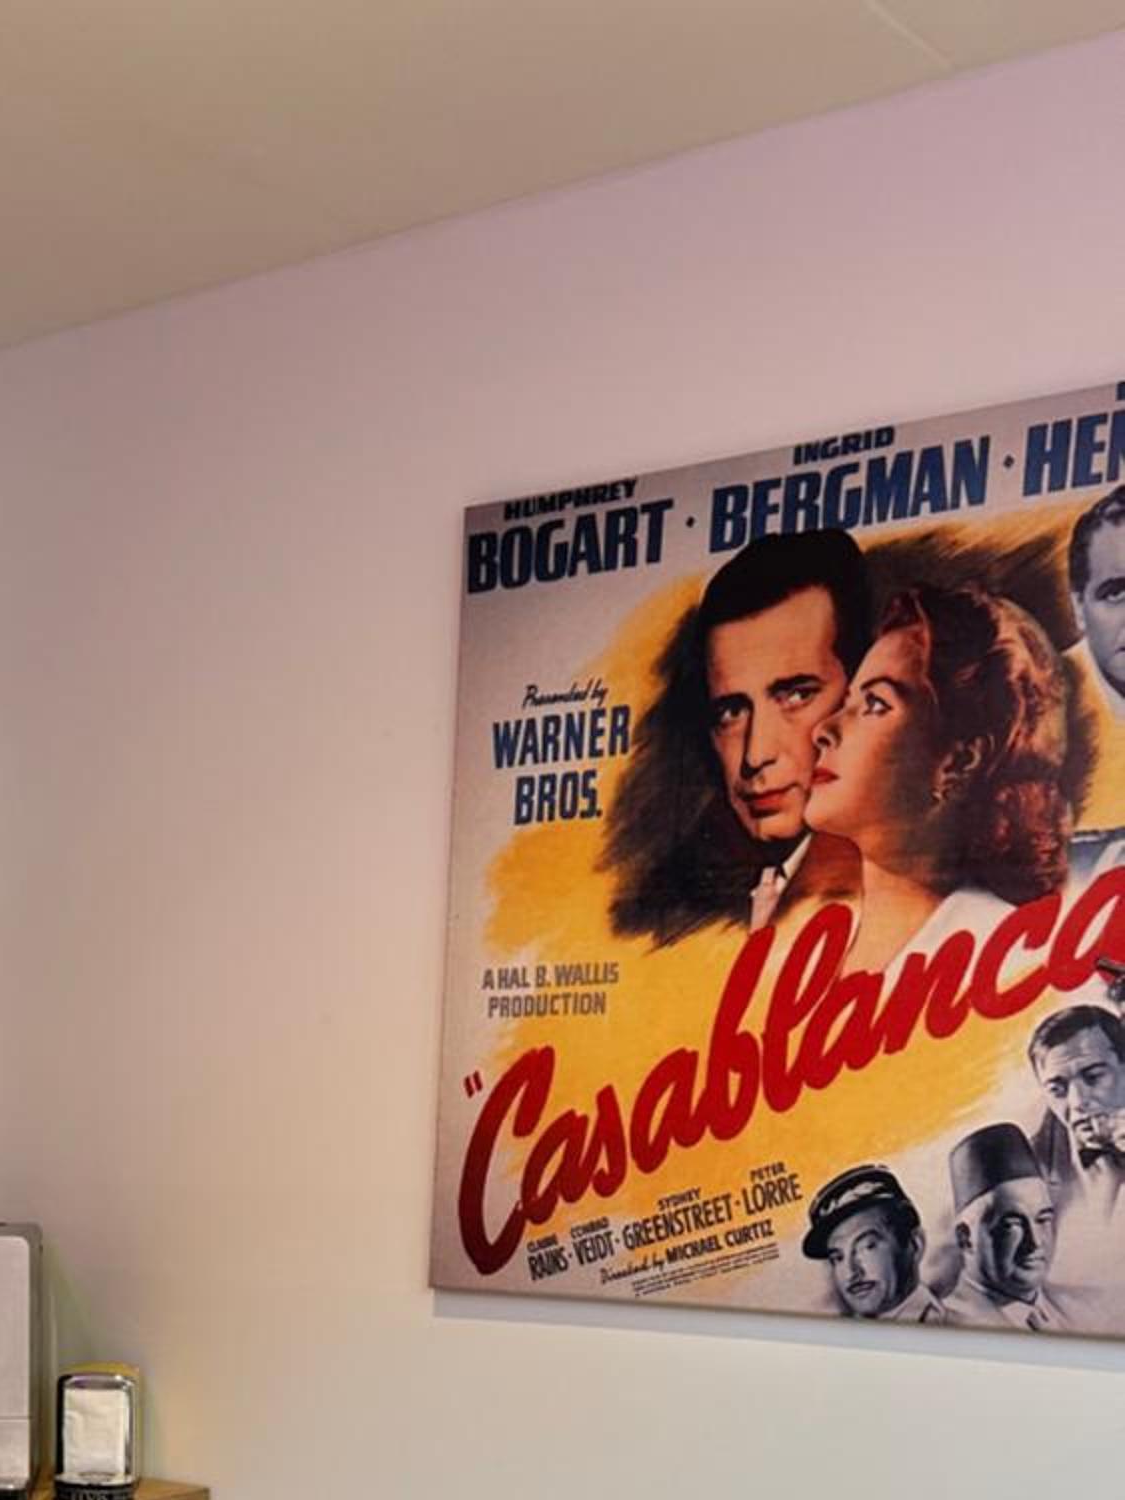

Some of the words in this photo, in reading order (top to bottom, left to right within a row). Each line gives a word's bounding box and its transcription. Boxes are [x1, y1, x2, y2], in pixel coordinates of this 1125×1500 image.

[793, 426, 895, 465] INGRID
[467, 498, 673, 594] BOGART
[709, 435, 991, 554] BERGMAN
[503, 479, 637, 520] HUMPHREY
[492, 704, 631, 769] WARNER
[514, 769, 602, 826] BROS.
[482, 968, 495, 990] A
[497, 965, 531, 989] HAL
[535, 964, 552, 988] B.
[554, 961, 620, 987] WALLIS
[487, 991, 607, 1019] PRODUCTION
[749, 1161, 787, 1183] PETER
[657, 1186, 702, 1212] SYDNEY
[527, 1245, 569, 1282] RAINS
[572, 1229, 615, 1266] VEIDT
[622, 1192, 734, 1251] GREENSTREET
[741, 1173, 804, 1216] LORRE
[666, 1235, 722, 1264] MICHAEL
[725, 1218, 775, 1248] CURTIZ
